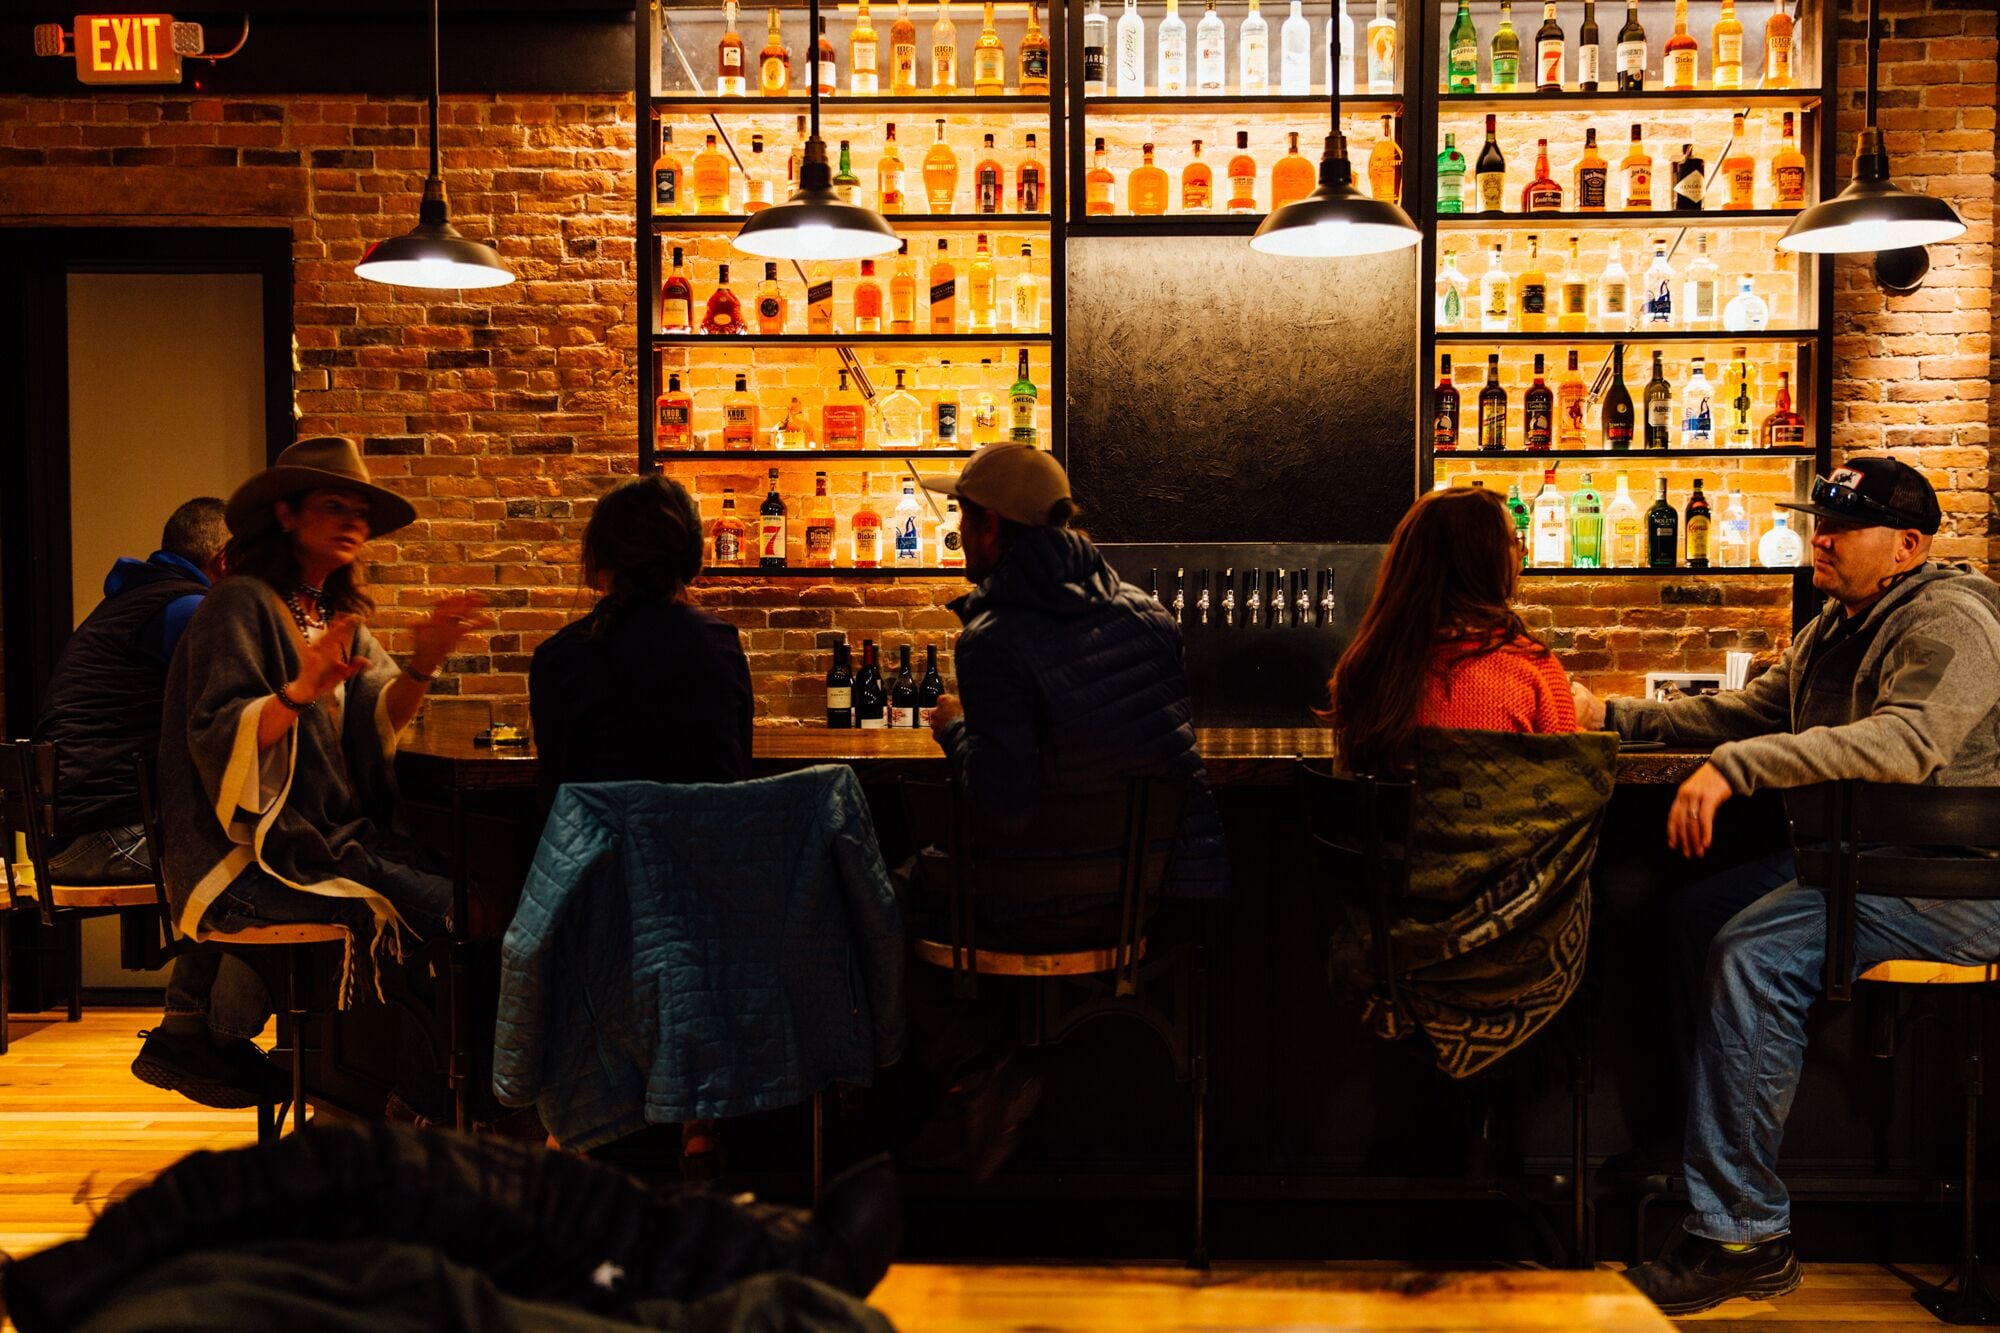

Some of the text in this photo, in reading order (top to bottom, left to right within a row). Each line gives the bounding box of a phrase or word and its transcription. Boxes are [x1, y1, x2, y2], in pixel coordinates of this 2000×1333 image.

[91, 18, 160, 71] EXIT
[1453, 47, 1475, 56] CARPAN
[1543, 51, 1562, 81] 7
[662, 409, 681, 417] KNOB
[727, 409, 745, 417] KNOB
[762, 525, 782, 555] 7
[810, 531, 831, 540] Dickel
[857, 532, 877, 540] Dickel
